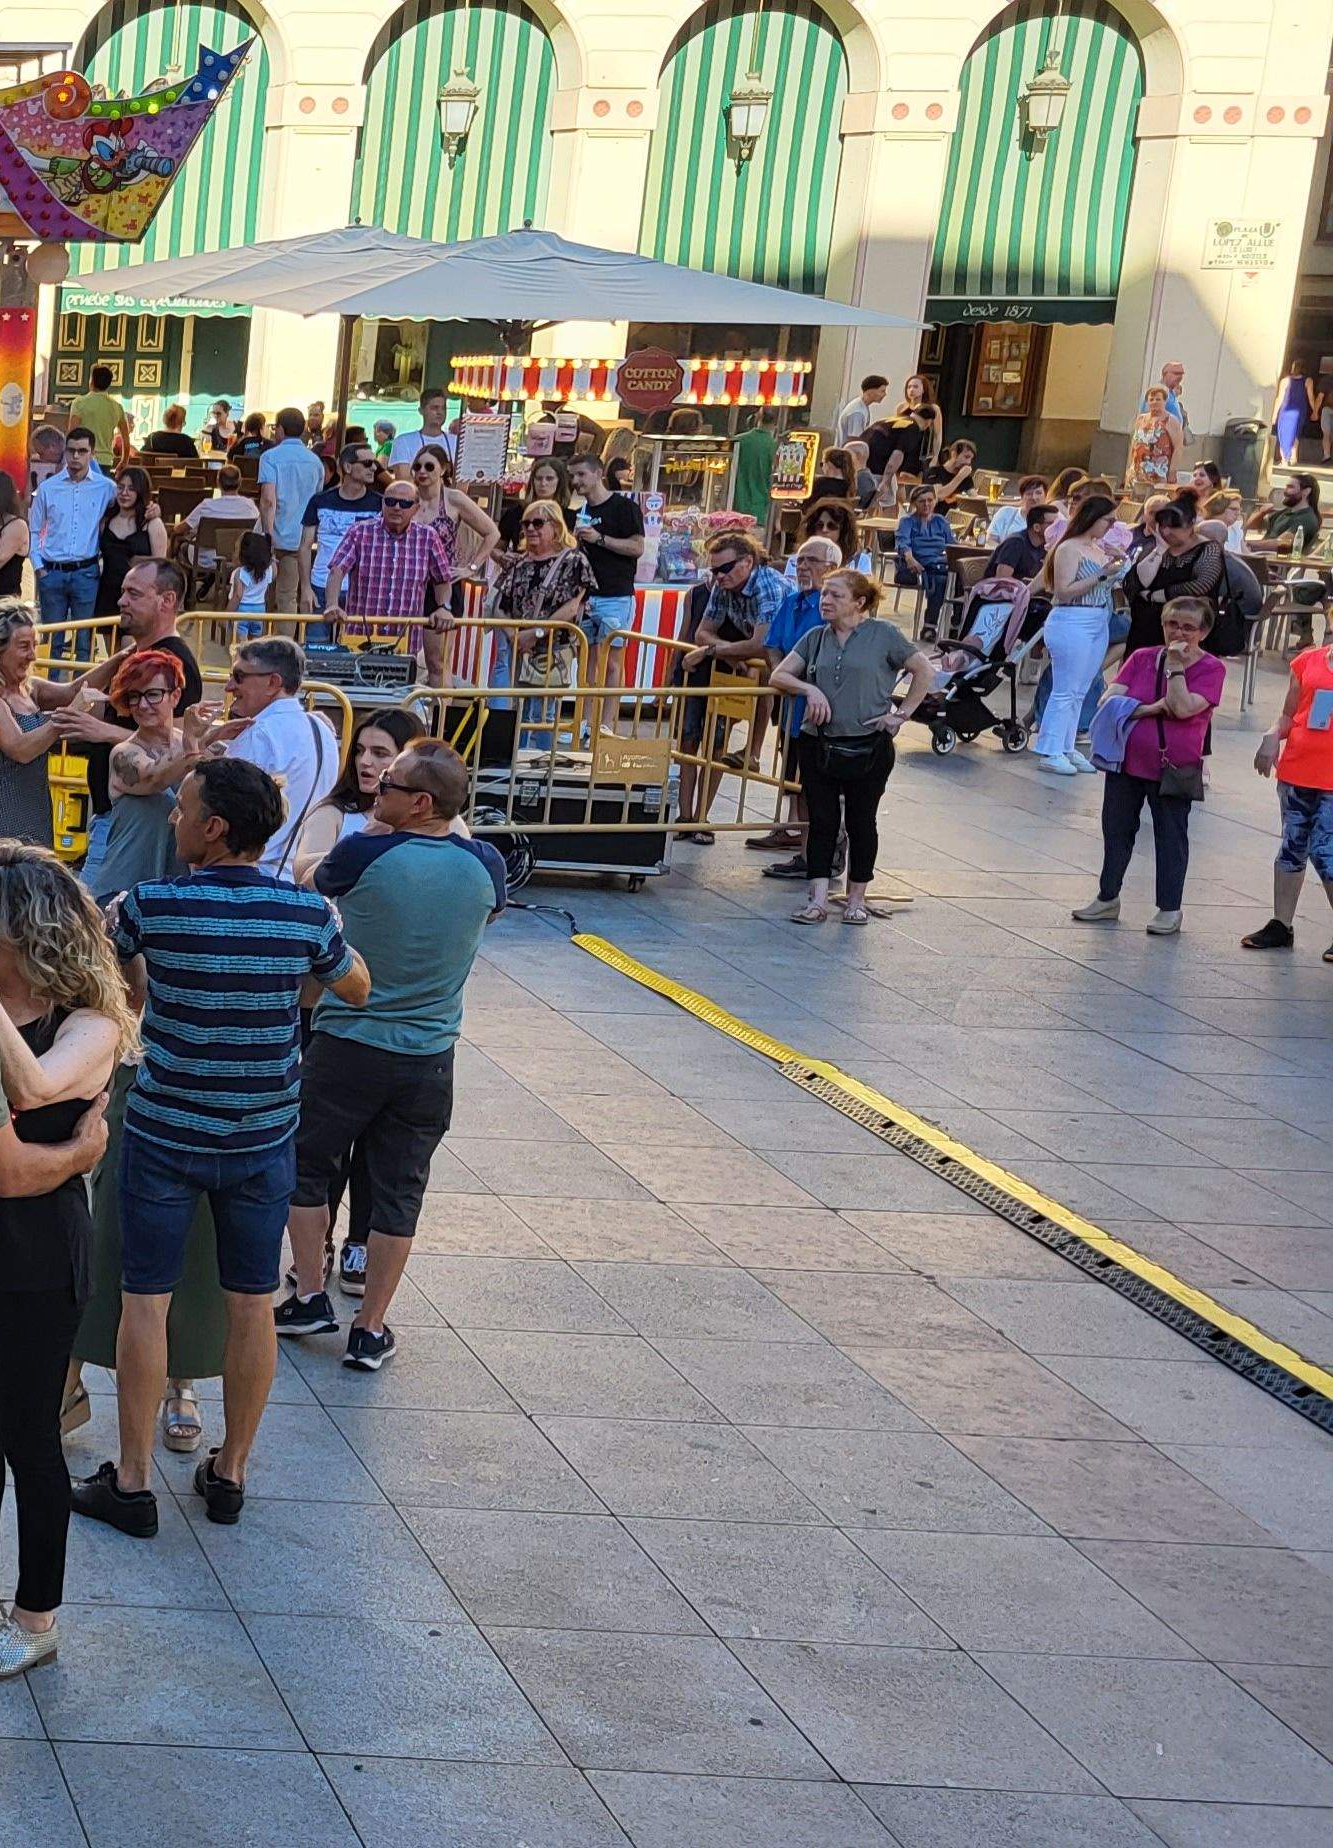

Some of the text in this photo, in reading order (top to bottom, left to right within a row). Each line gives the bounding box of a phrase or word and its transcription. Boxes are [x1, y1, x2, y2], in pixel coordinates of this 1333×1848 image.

[962, 302, 1033, 319] desde 1871
[625, 367, 677, 380] COTTON
[627, 380, 673, 391] CANDY
